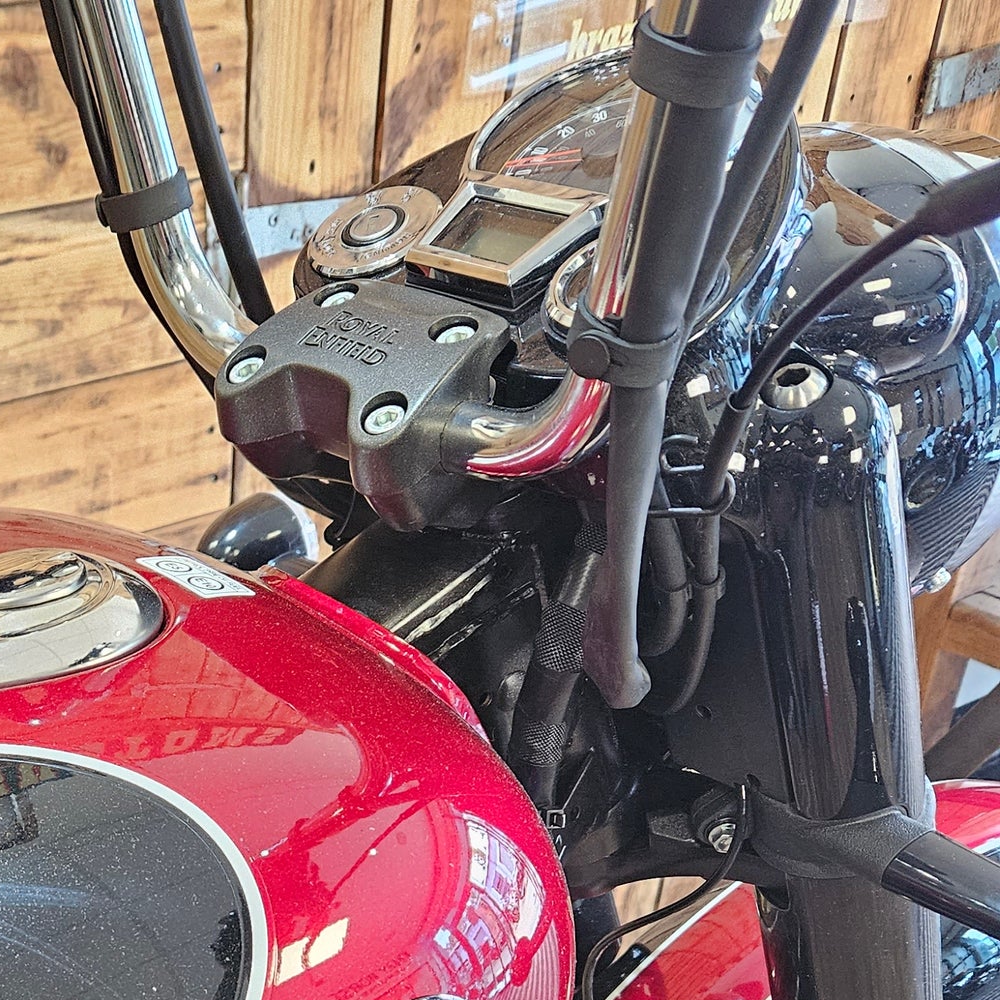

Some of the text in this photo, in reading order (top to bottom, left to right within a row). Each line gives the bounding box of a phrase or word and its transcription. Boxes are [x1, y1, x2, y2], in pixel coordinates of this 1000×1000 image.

[592, 110, 608, 123] 30
[556, 125, 576, 139] 20
[584, 128, 596, 138] 40
[323, 310, 399, 345] ROYAL
[297, 325, 388, 366] ENFIELD
